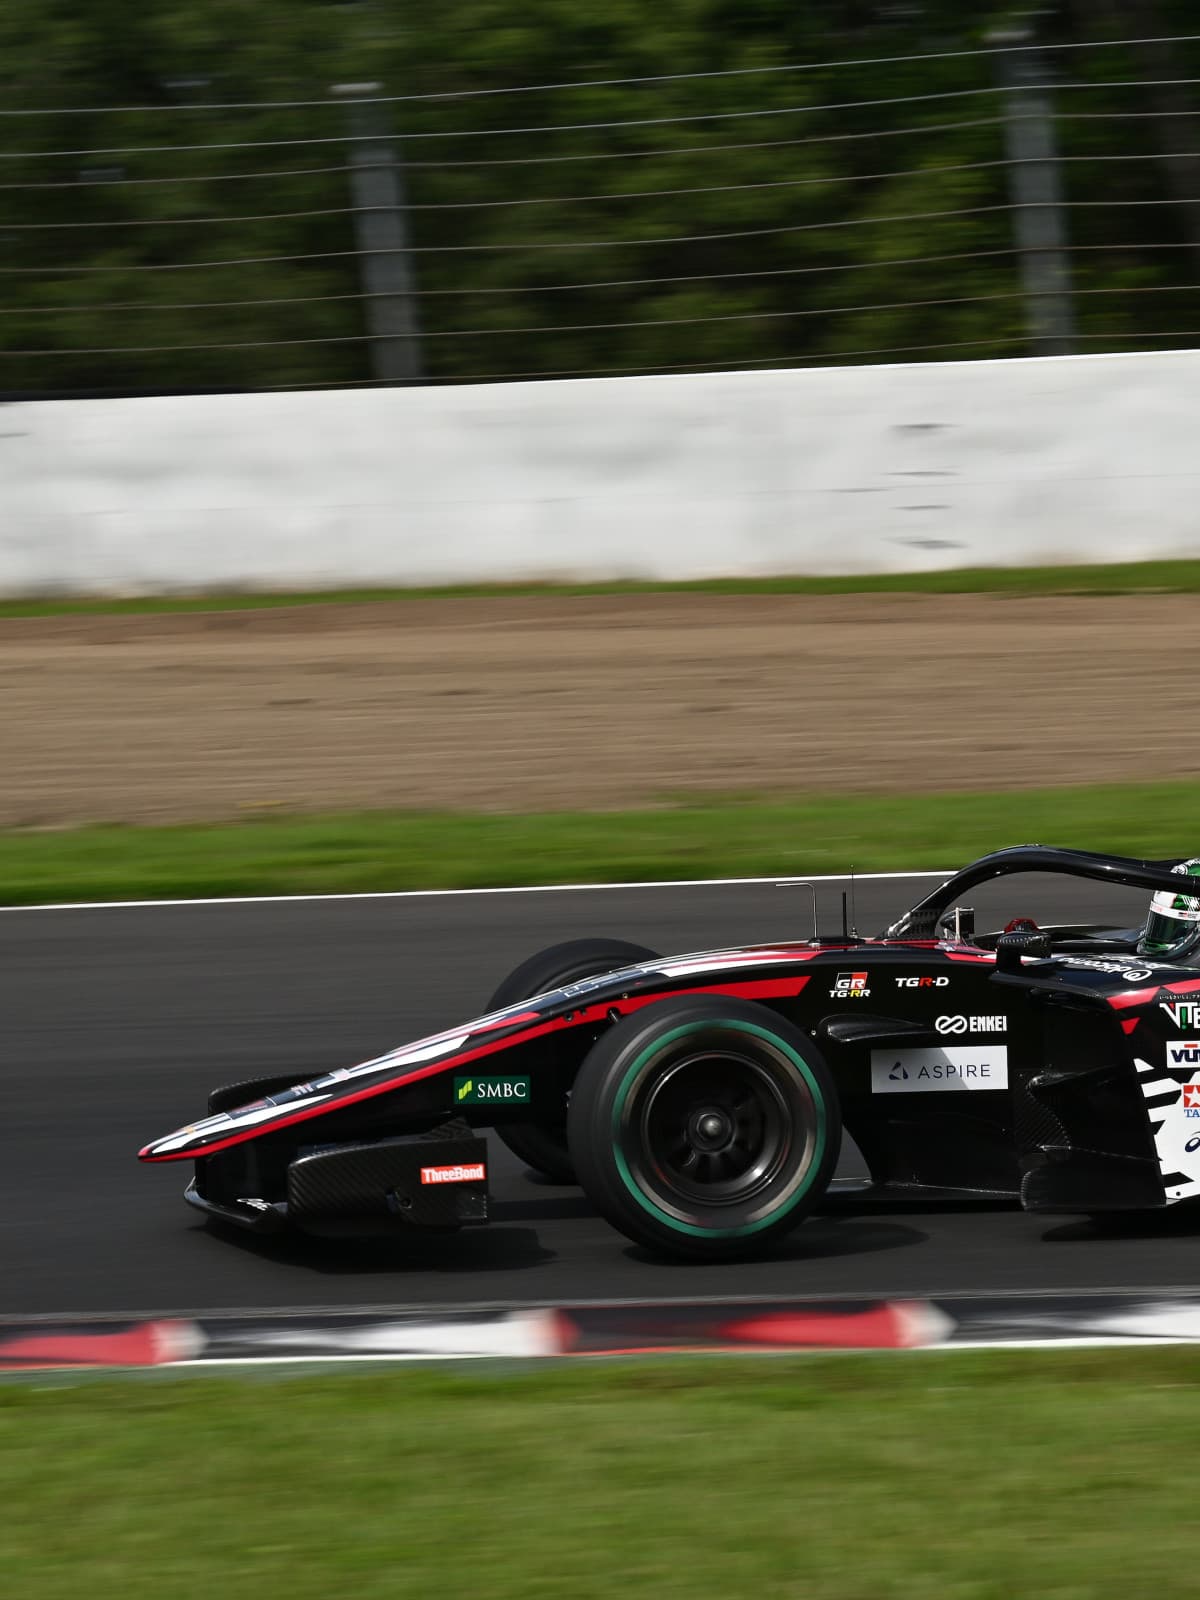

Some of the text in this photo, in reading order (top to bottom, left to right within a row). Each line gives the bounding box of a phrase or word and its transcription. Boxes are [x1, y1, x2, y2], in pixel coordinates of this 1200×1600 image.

[836, 979, 865, 989] GR
[969, 1016, 1008, 1032] ENKEI
[917, 1064, 991, 1079] ASPIRE
[477, 1082, 526, 1098] SMBC
[422, 1165, 484, 1184] ThreeBond
